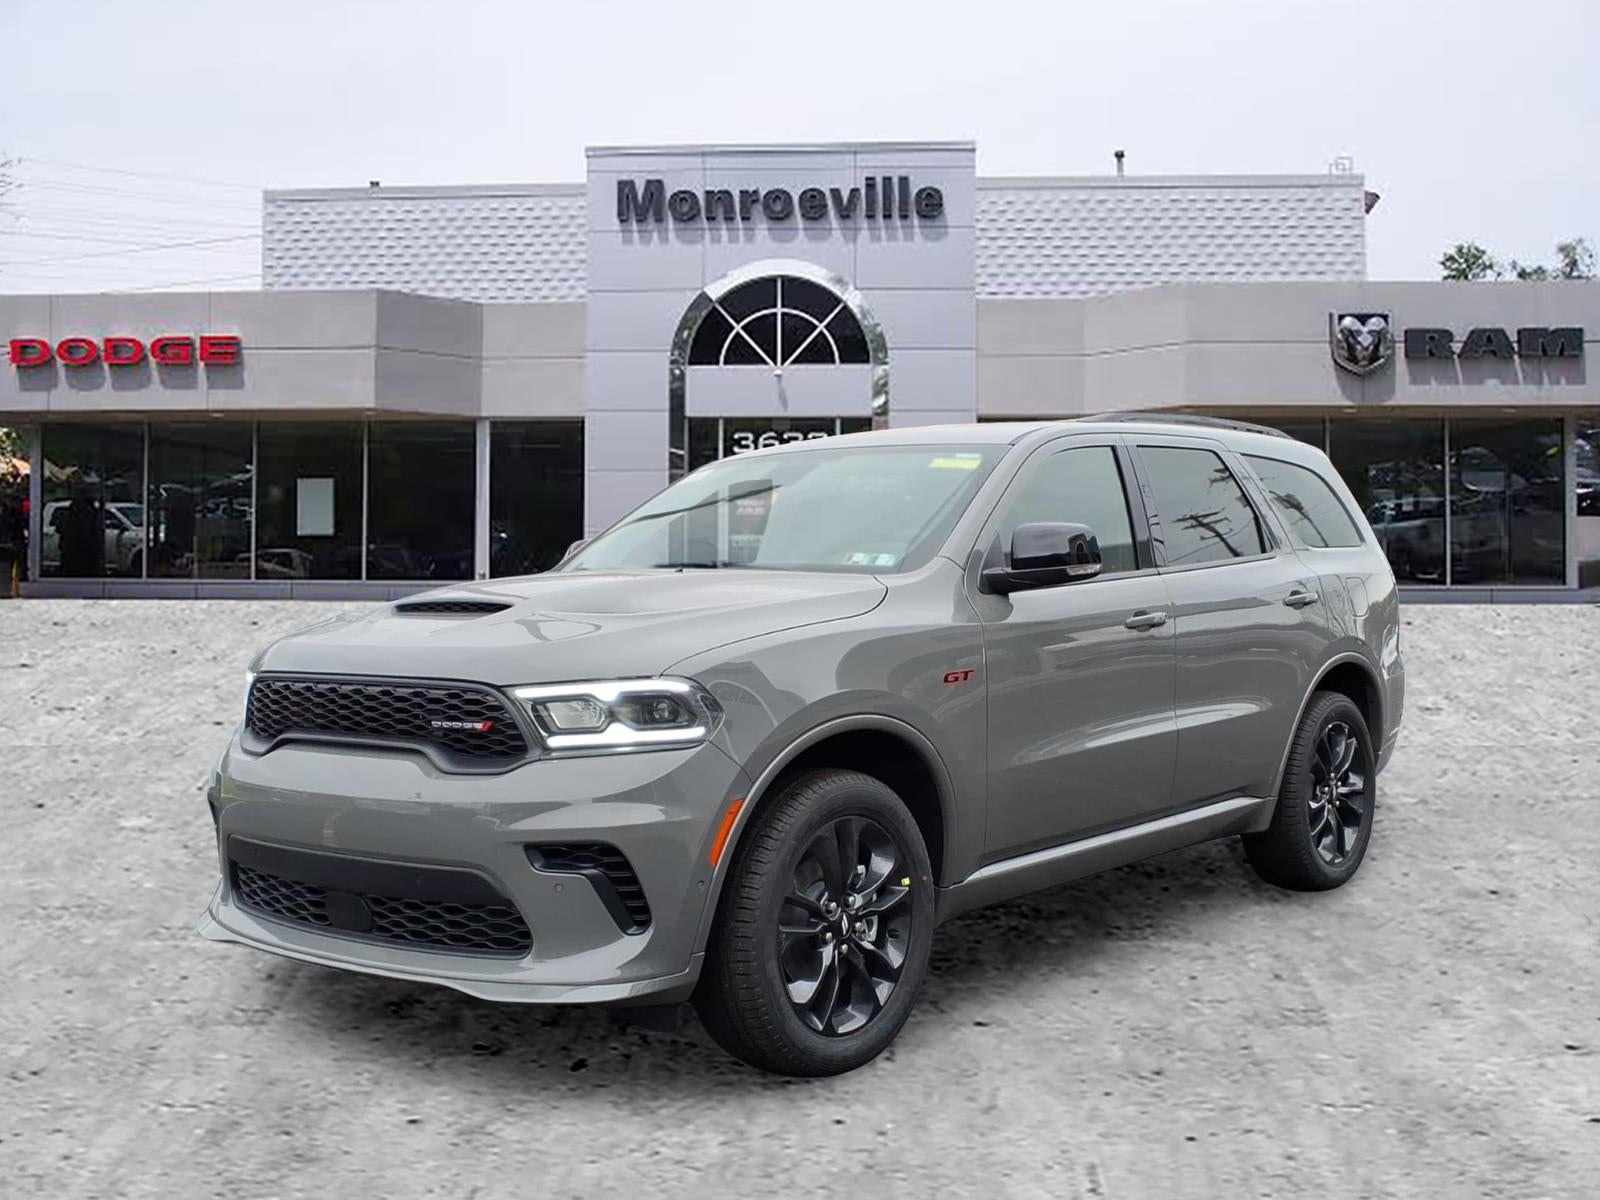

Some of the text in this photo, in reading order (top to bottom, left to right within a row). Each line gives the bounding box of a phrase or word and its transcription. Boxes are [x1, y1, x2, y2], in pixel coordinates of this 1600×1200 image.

[617, 176, 944, 222] Monroeville
[9, 335, 241, 365] DODGE
[1404, 327, 1584, 359] RAM
[733, 431, 829, 453] 36
[943, 669, 976, 684] GT
